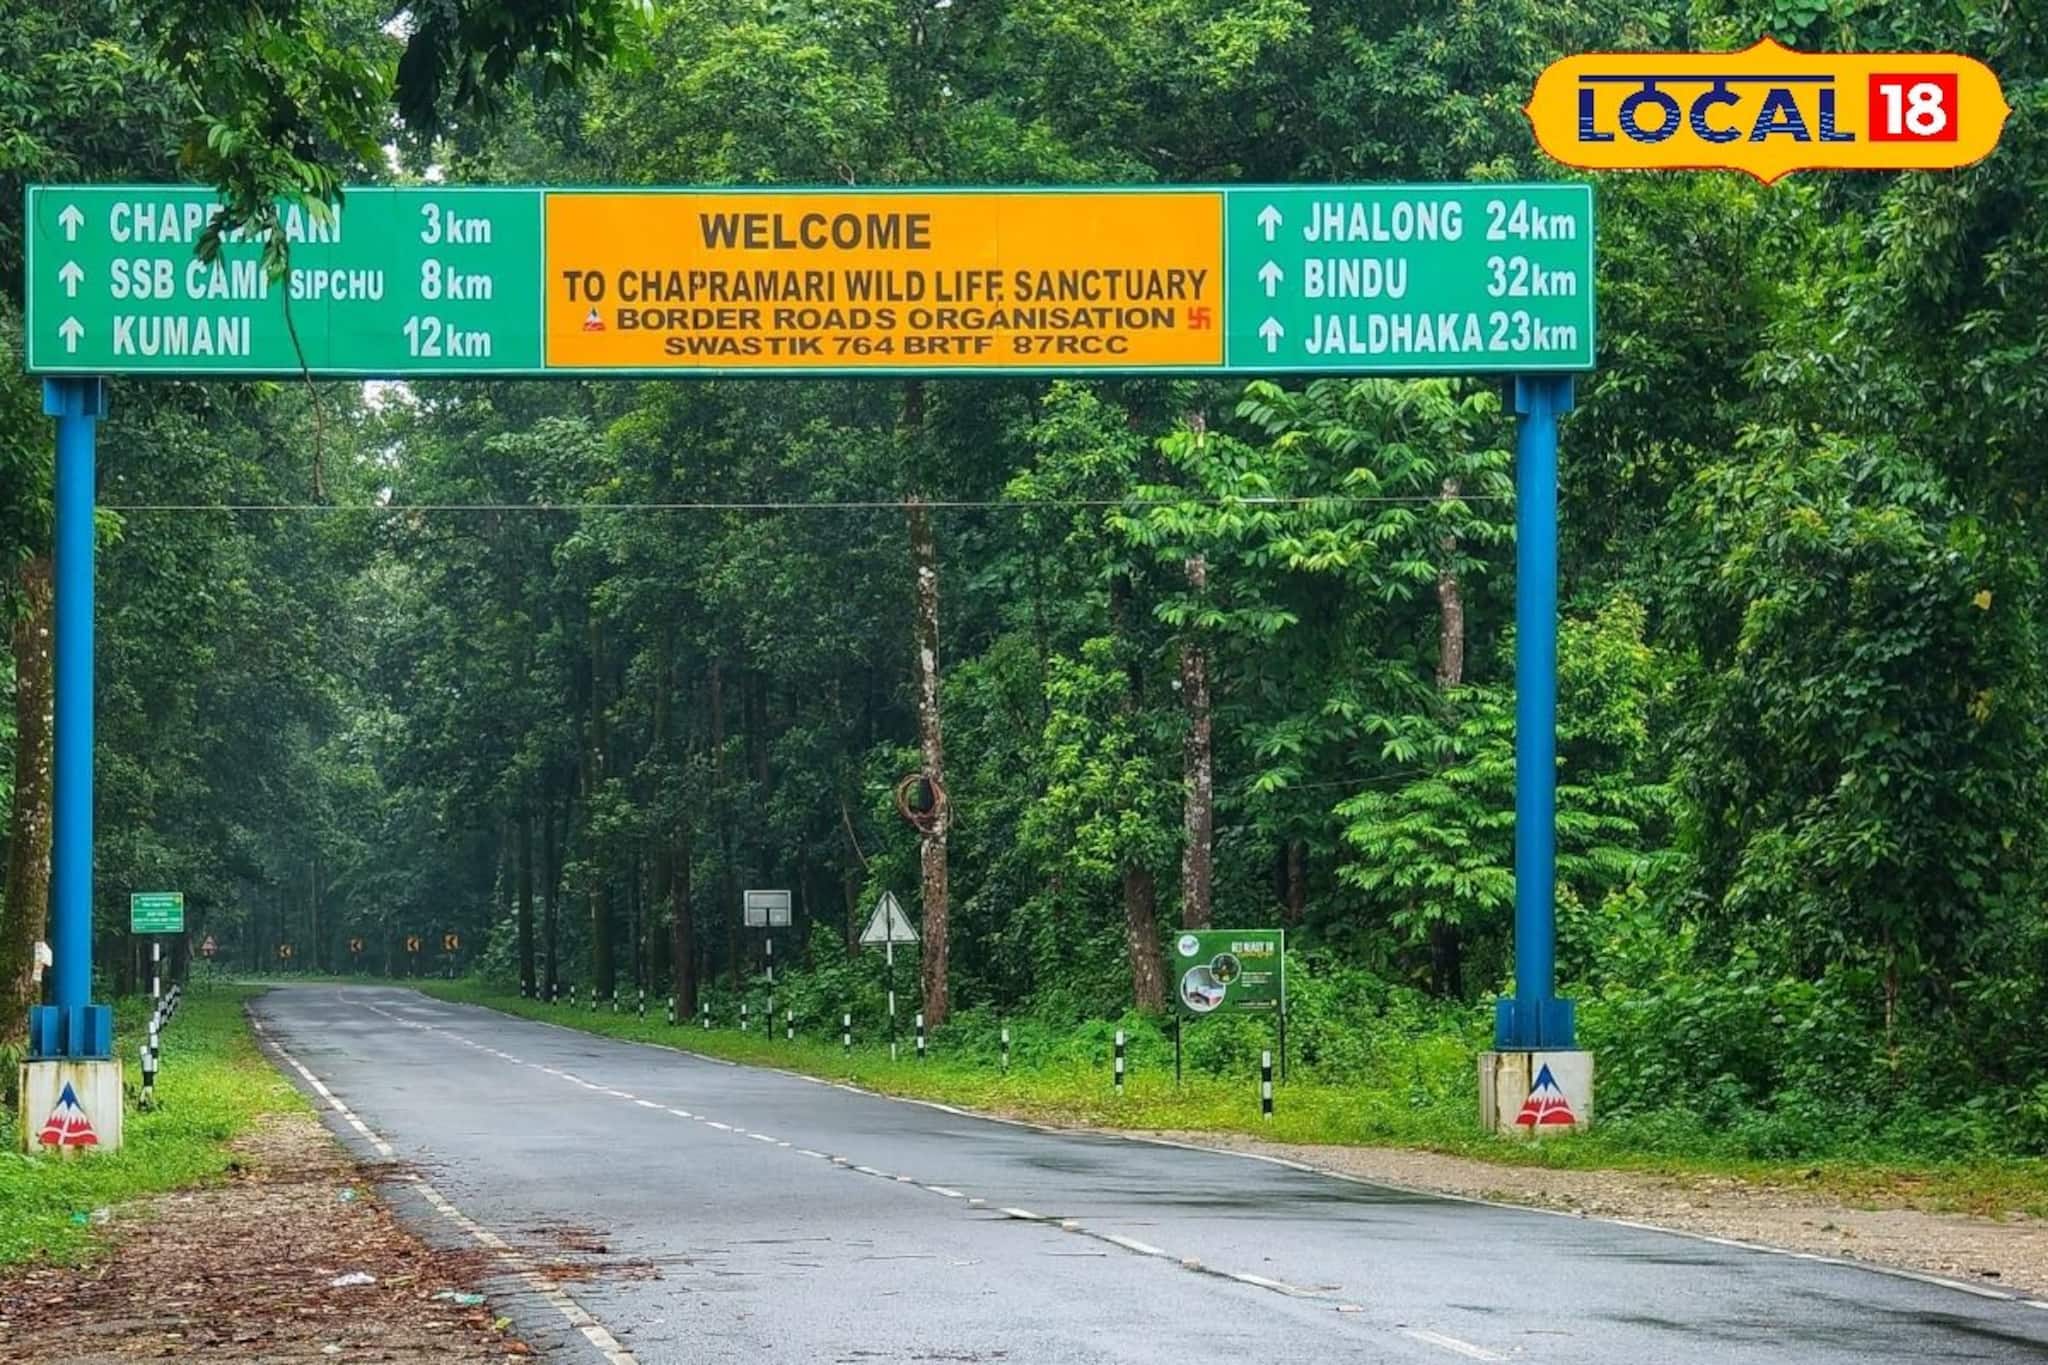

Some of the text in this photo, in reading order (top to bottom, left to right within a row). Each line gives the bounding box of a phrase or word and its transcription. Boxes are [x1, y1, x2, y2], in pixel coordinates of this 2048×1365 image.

[699, 213, 931, 249] WELCOME
[1304, 200, 1576, 241] JHALONG 24km
[111, 259, 174, 298] SSB
[289, 269, 384, 300] SIPCHU
[563, 271, 606, 302] TO
[618, 271, 835, 302] CHAPRAMARI
[845, 270, 926, 302] WILD
[1014, 269, 1207, 302] SANCTUARY
[1305, 256, 1576, 298] BINDU 32km
[113, 316, 250, 356] KUMANI
[617, 307, 1175, 331] BORDER ROADS ORGANISATION
[1305, 311, 1577, 354] JALDHAKA 23km
[664, 335, 1129, 356] SWASTIK 764 BRTF 87RCC
